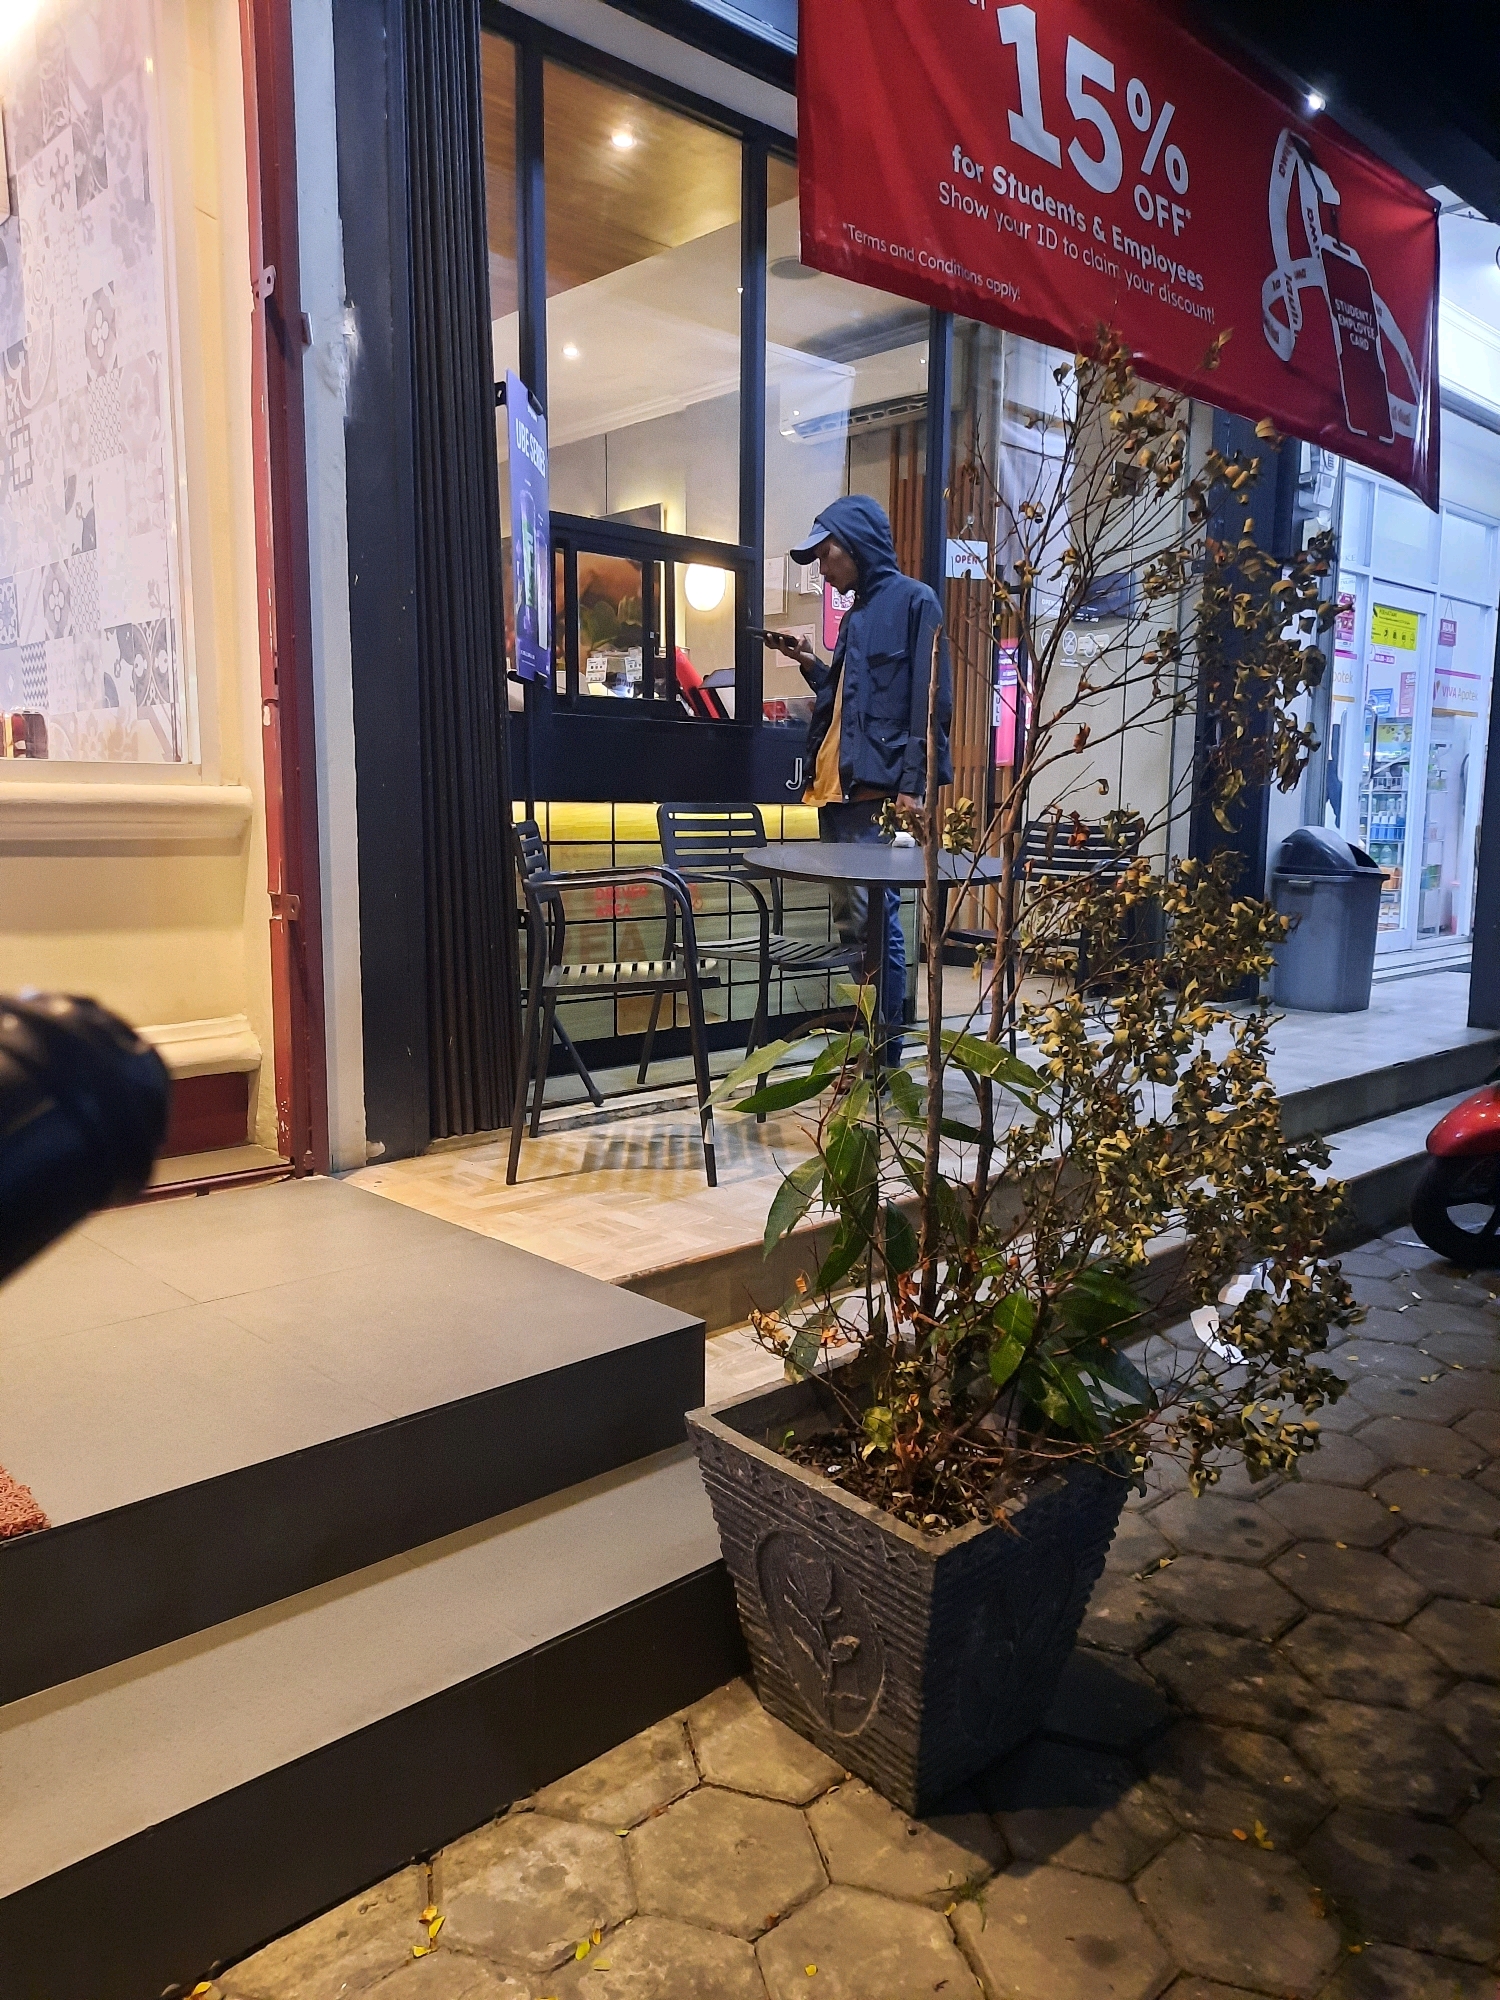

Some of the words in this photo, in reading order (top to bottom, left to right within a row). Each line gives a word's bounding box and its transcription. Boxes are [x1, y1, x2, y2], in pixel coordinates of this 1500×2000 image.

[996, 4, 1189, 195] 15%
[939, 181, 989, 220] Show
[993, 208, 1032, 240] your
[1037, 223, 1058, 250] ID
[1062, 236, 1079, 259] to
[1082, 247, 1120, 279] claim
[1124, 269, 1155, 296] your
[1158, 284, 1215, 325] discount!
[951, 144, 984, 183] for
[992, 165, 1086, 232] Students
[1092, 215, 1107, 243] &
[1112, 225, 1204, 291] Employees
[889, 243, 915, 262] and
[918, 250, 984, 287] Conditions
[985, 276, 1021, 303] apply!
[515, 417, 530, 458] UBE
[954, 554, 978, 565] OPEN
